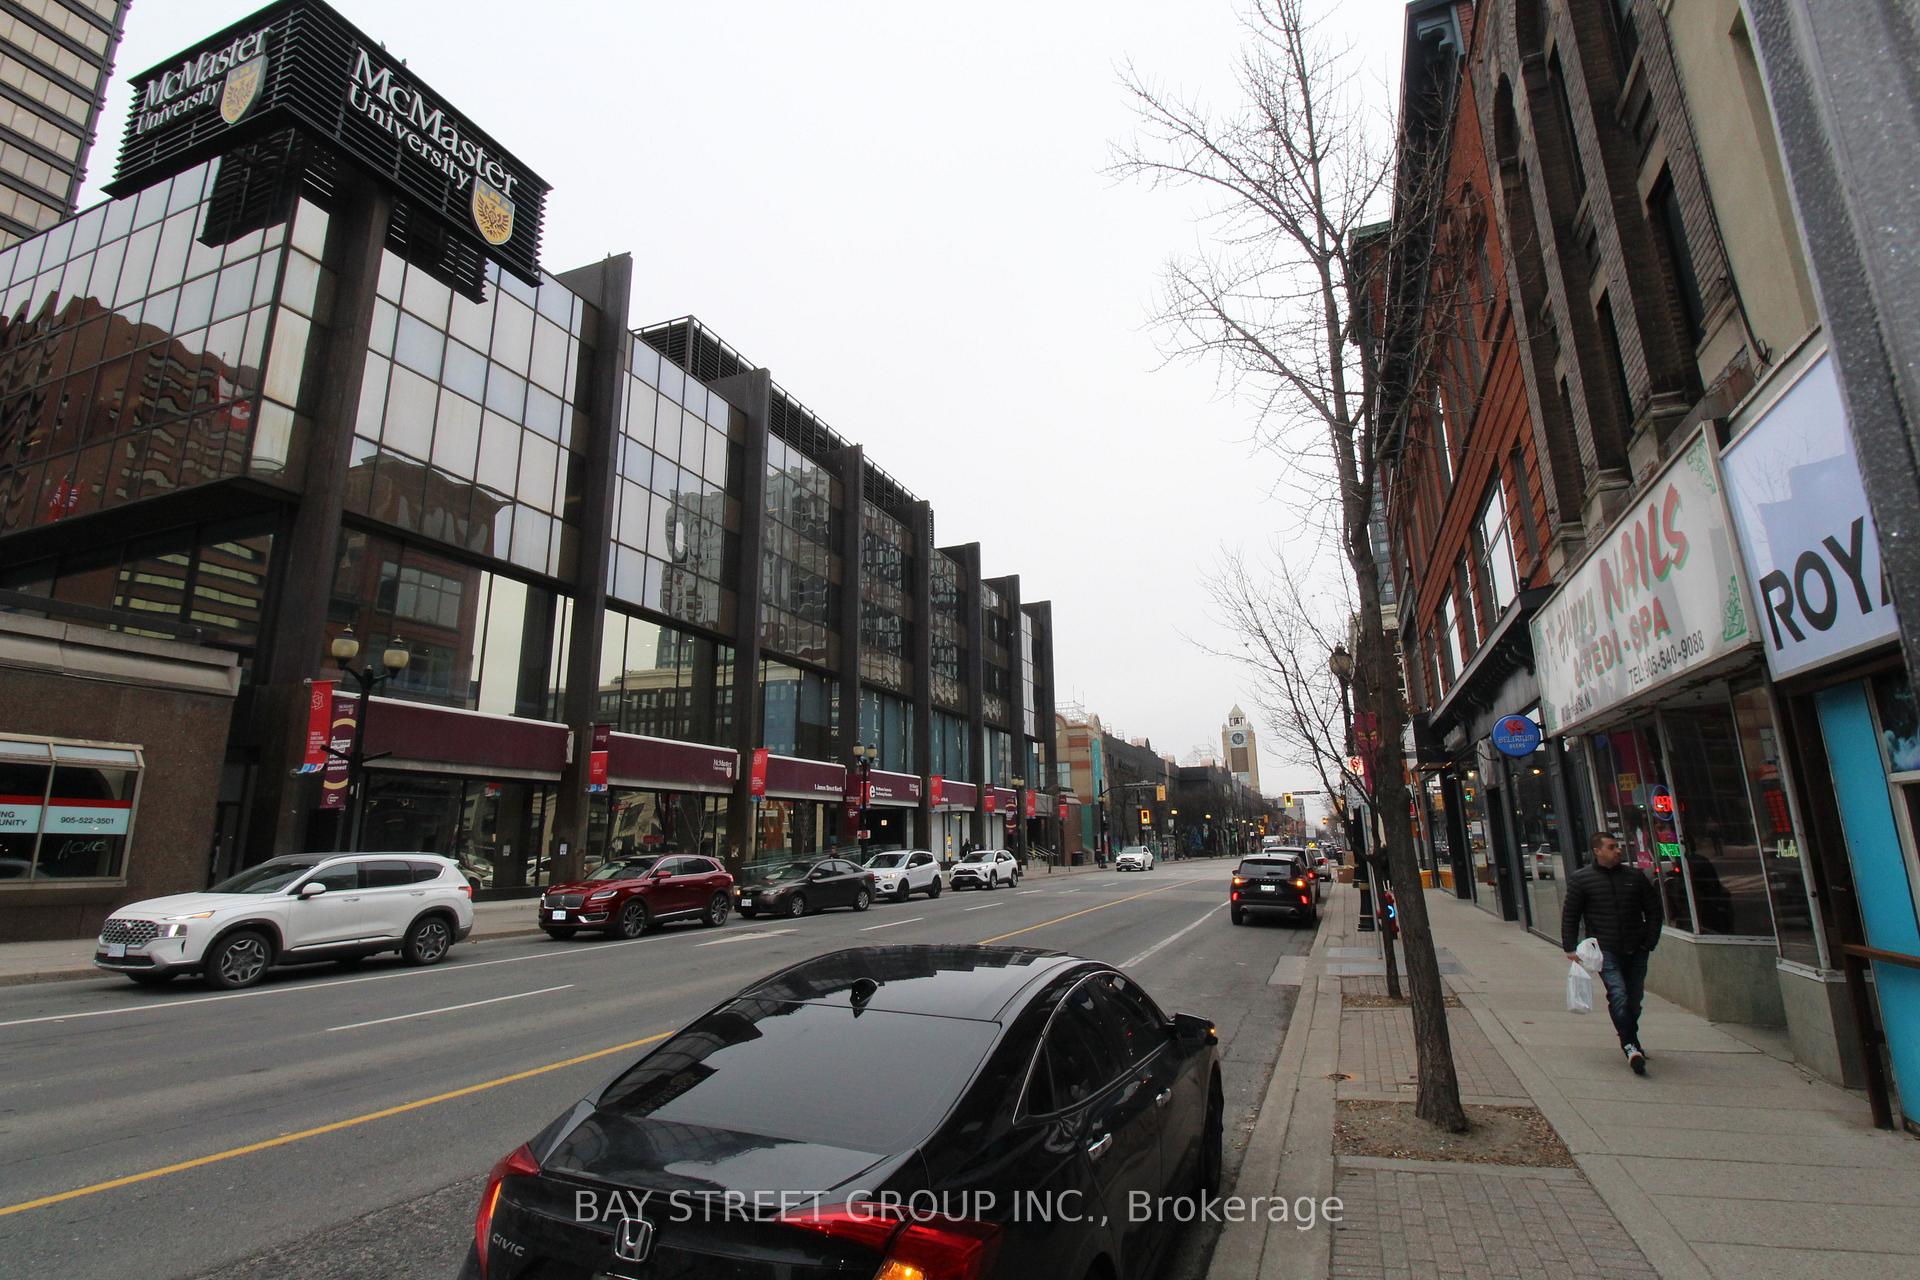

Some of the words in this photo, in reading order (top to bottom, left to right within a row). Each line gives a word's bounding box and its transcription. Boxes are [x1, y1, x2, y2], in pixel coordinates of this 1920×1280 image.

[142, 27, 273, 113] McMaster
[135, 80, 224, 136] University
[349, 81, 472, 190] University
[351, 47, 518, 199] McMaster
[1600, 483, 1690, 622] NAILS
[1629, 597, 1671, 651] SPA
[61, 816, 115, 824] 905-522-3501
[492, 1232, 525, 1257] CIVIC
